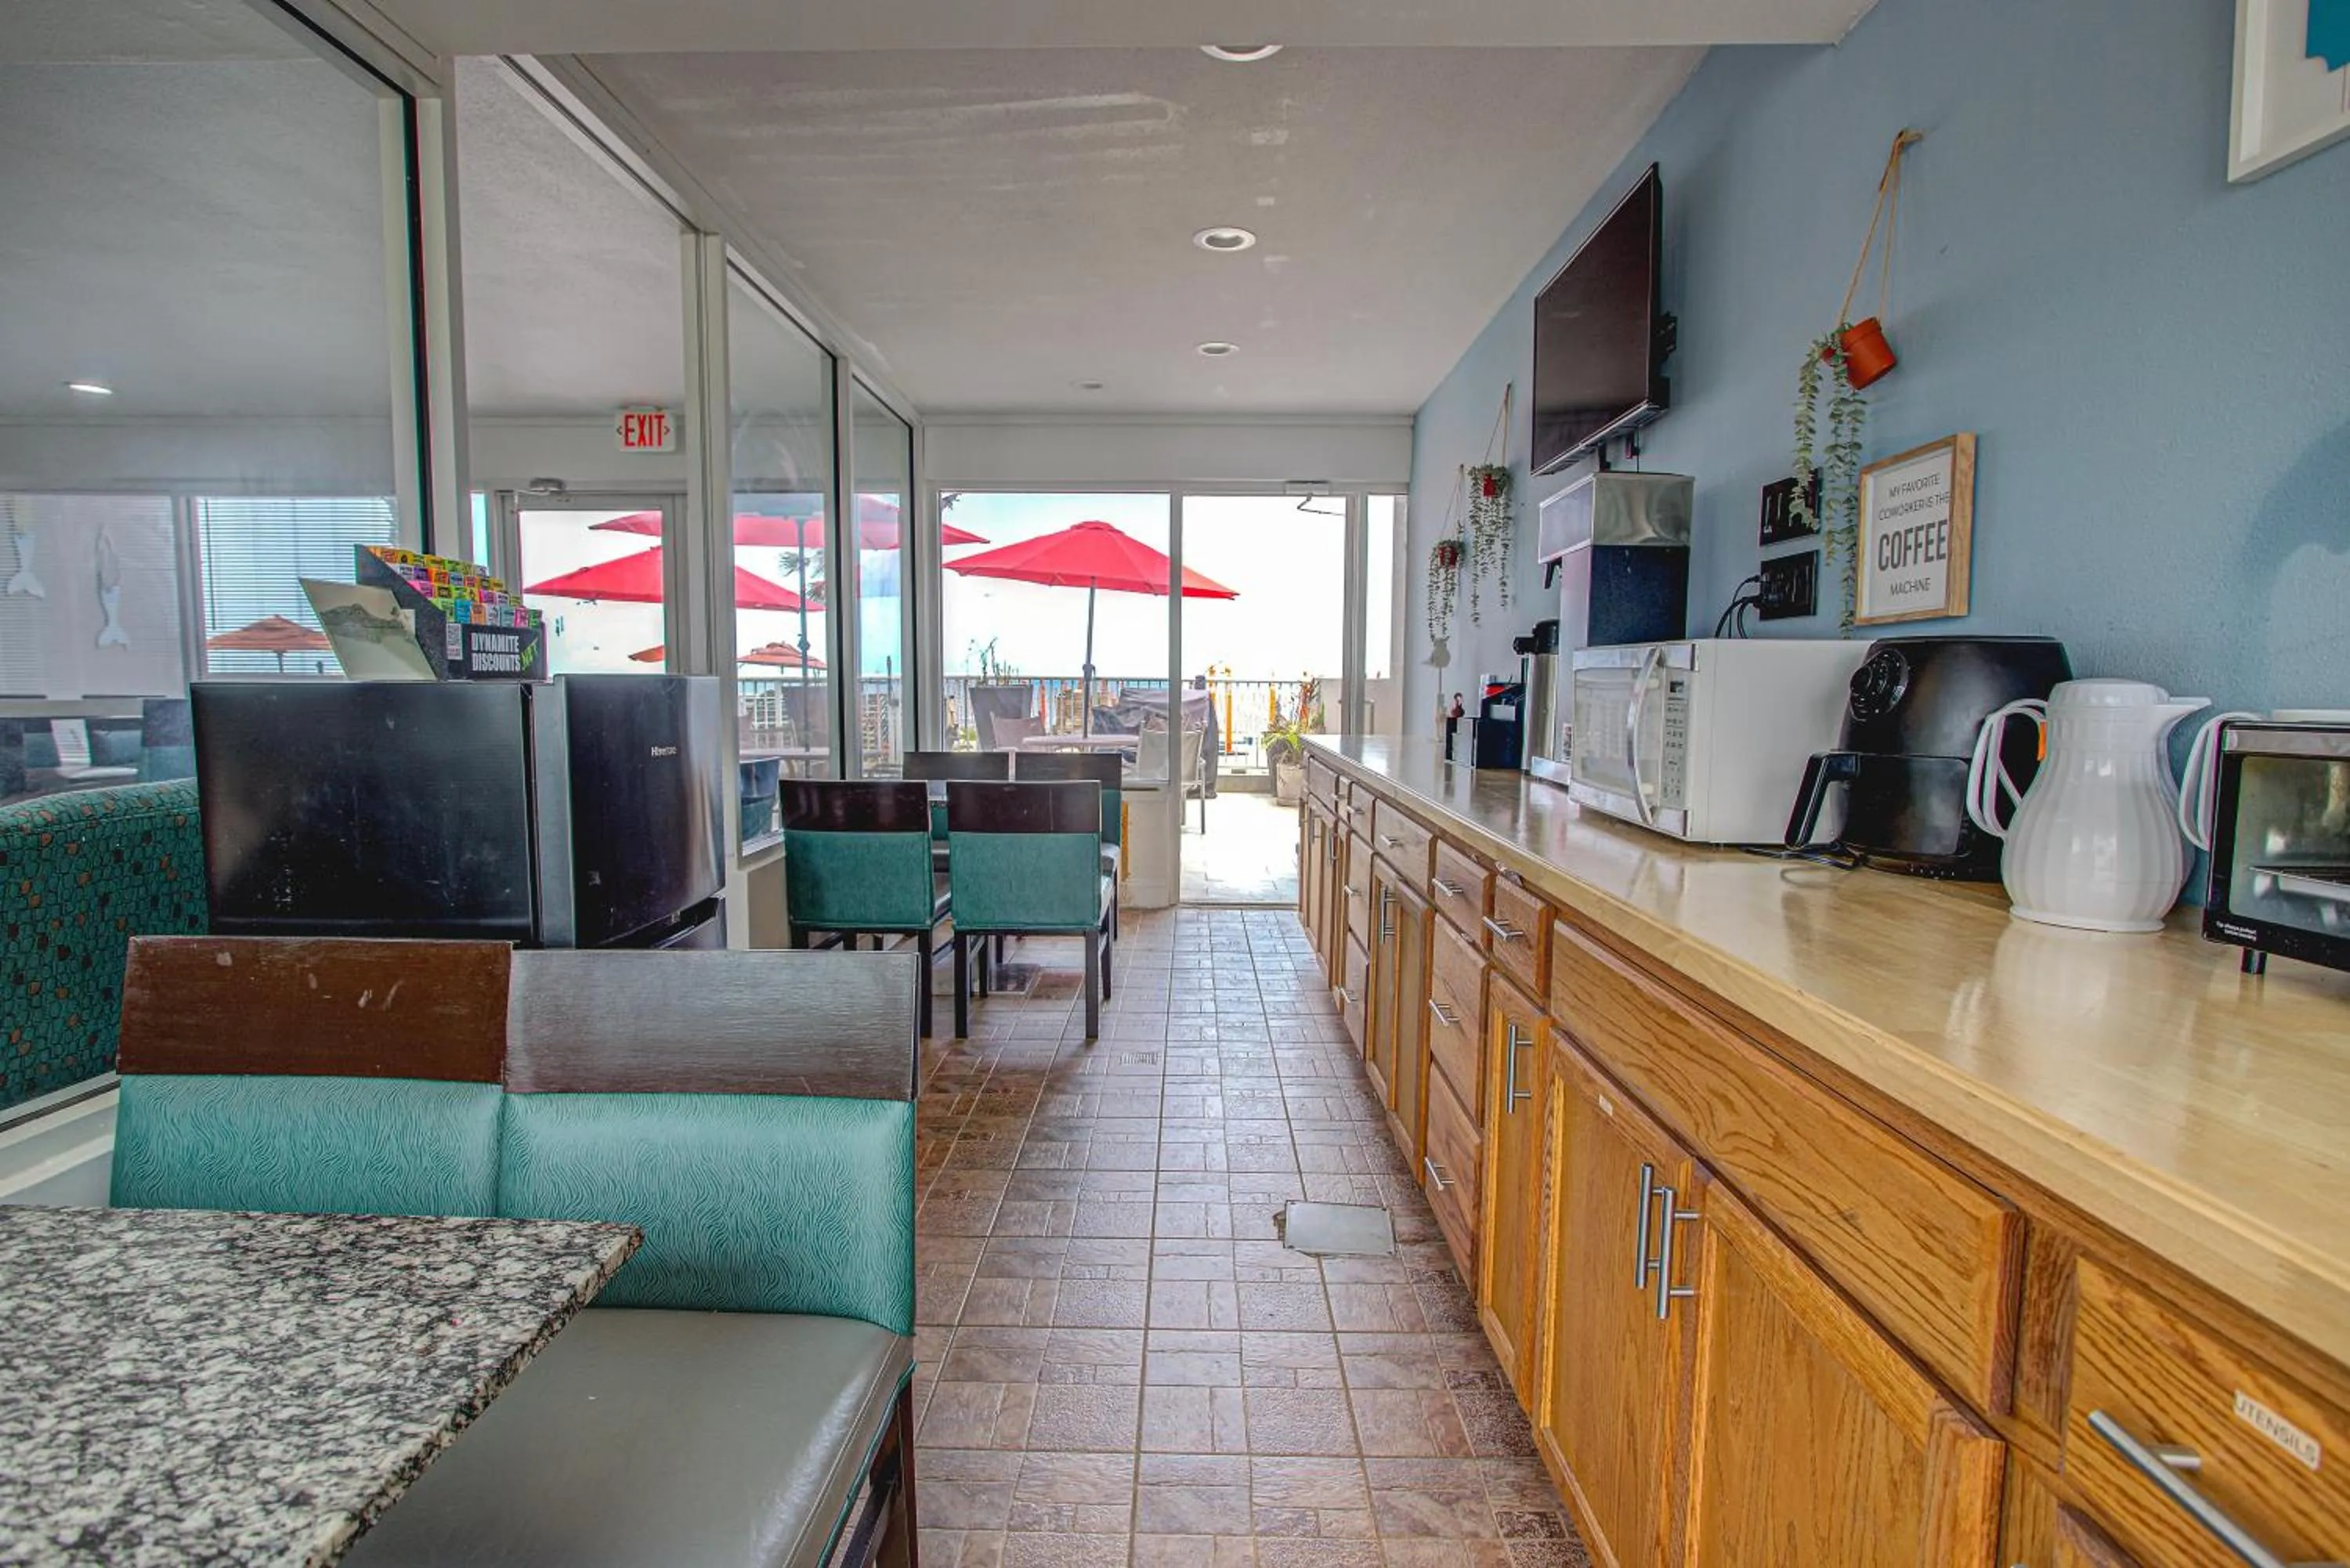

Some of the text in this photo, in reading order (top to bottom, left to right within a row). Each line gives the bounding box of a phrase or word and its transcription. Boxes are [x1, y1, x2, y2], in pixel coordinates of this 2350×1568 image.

[624, 414, 665, 447] EXIT
[1889, 472, 1940, 498] MY FAVORITE
[1933, 491, 1950, 506] THE
[1878, 518, 1948, 571] COFFEE
[1889, 577, 1931, 595] MACHINE
[471, 632, 519, 652] DYNAMITE
[471, 652, 521, 671] DISCOUNTS
